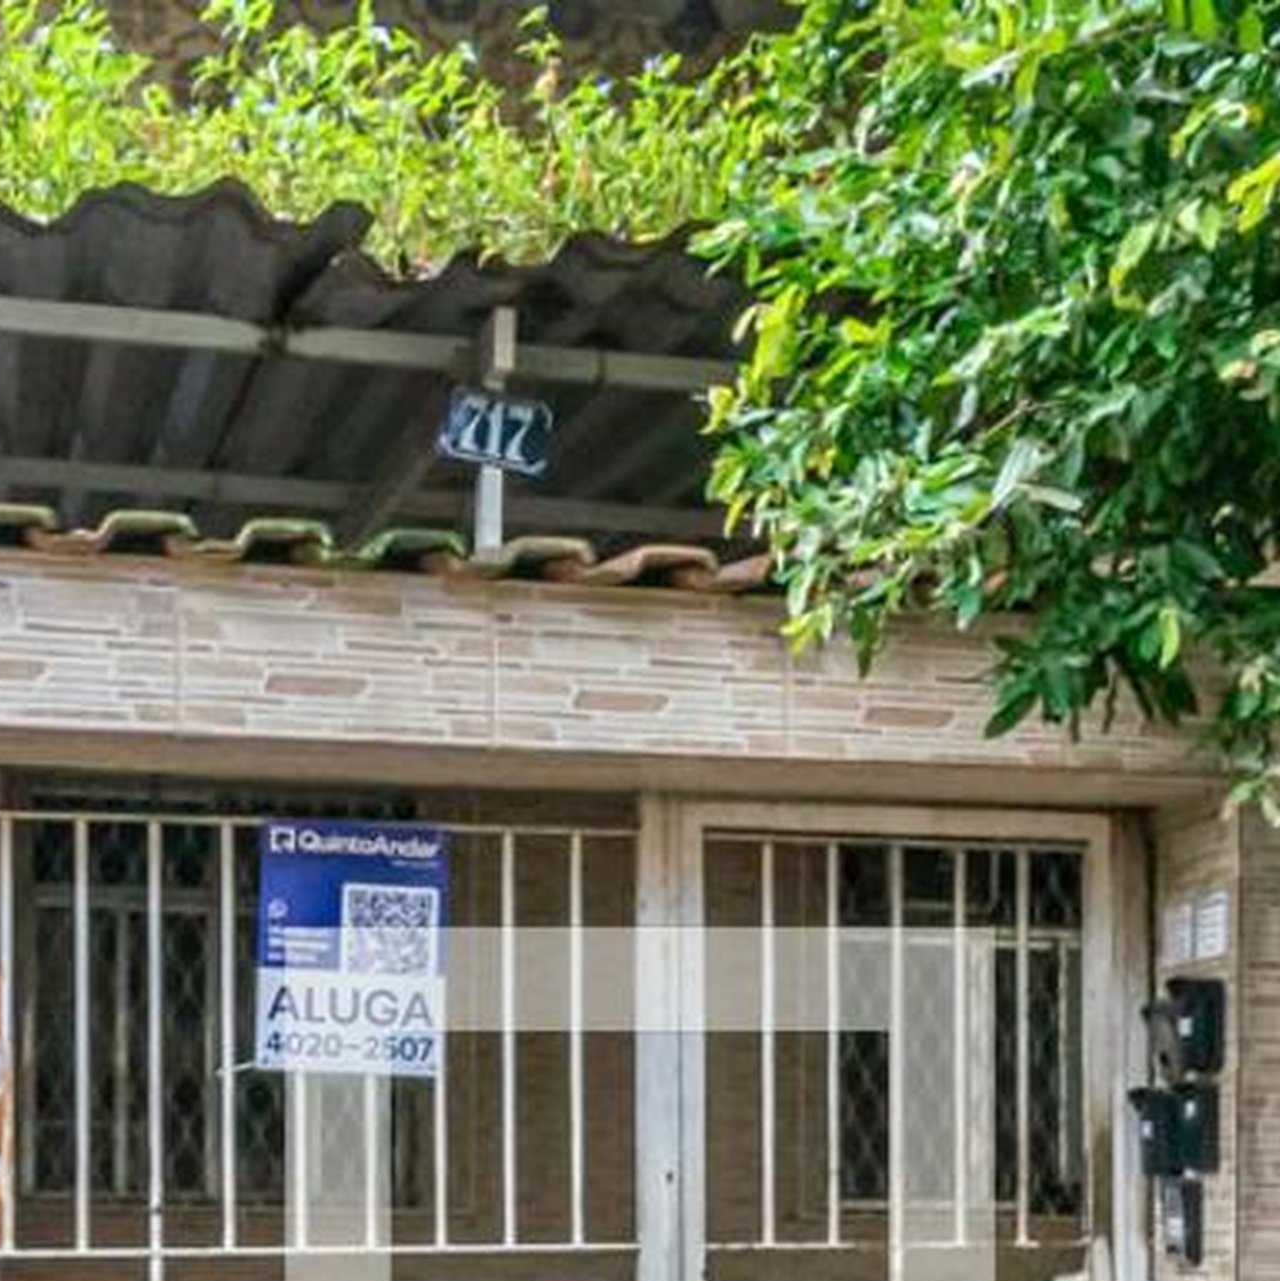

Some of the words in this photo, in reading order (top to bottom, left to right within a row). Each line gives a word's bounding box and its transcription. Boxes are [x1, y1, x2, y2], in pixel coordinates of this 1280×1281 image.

[297, 829, 440, 859] QuintoAndar
[268, 985, 433, 1027] ALUGA
[266, 1031, 434, 1062] 4020-2507
